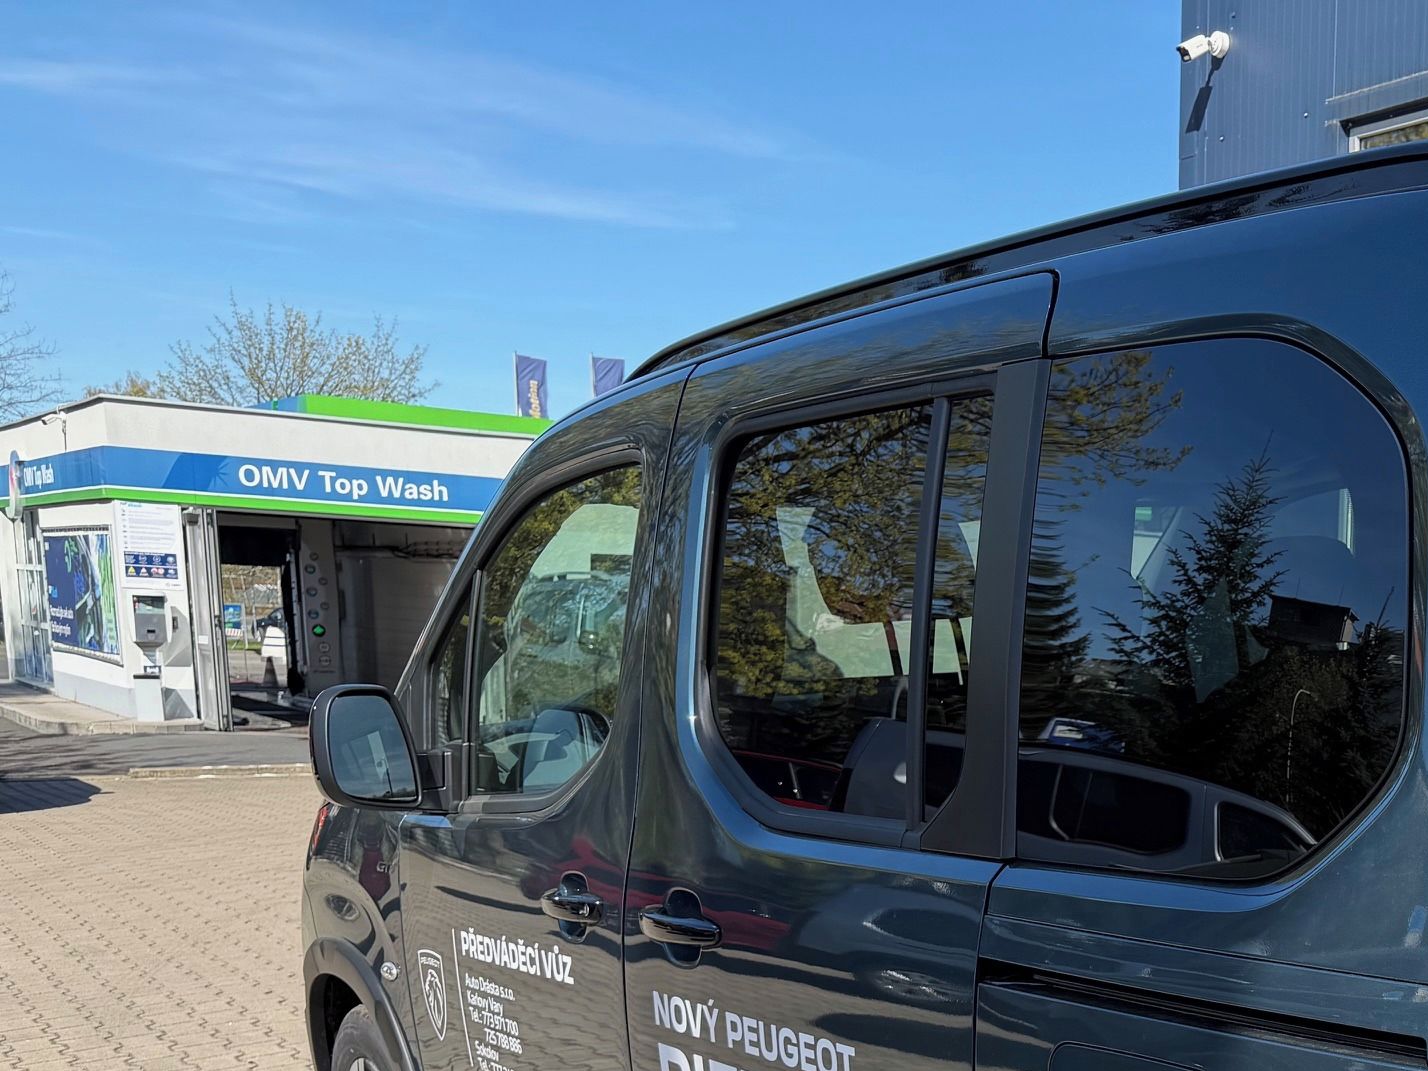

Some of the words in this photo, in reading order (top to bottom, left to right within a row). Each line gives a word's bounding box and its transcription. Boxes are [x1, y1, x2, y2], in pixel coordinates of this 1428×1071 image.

[238, 464, 310, 491] OMV
[318, 470, 368, 500] Top
[375, 475, 449, 501] Wash
[460, 927, 541, 976] PŘEDVÁDĚCÍ
[541, 945, 575, 985] VŮZ
[465, 972, 479, 990] Auto
[467, 989, 488, 1011] Karlovy
[488, 996, 503, 1017] Vary
[652, 990, 719, 1043] NOVÝ
[475, 1040, 499, 1061] Sokolov
